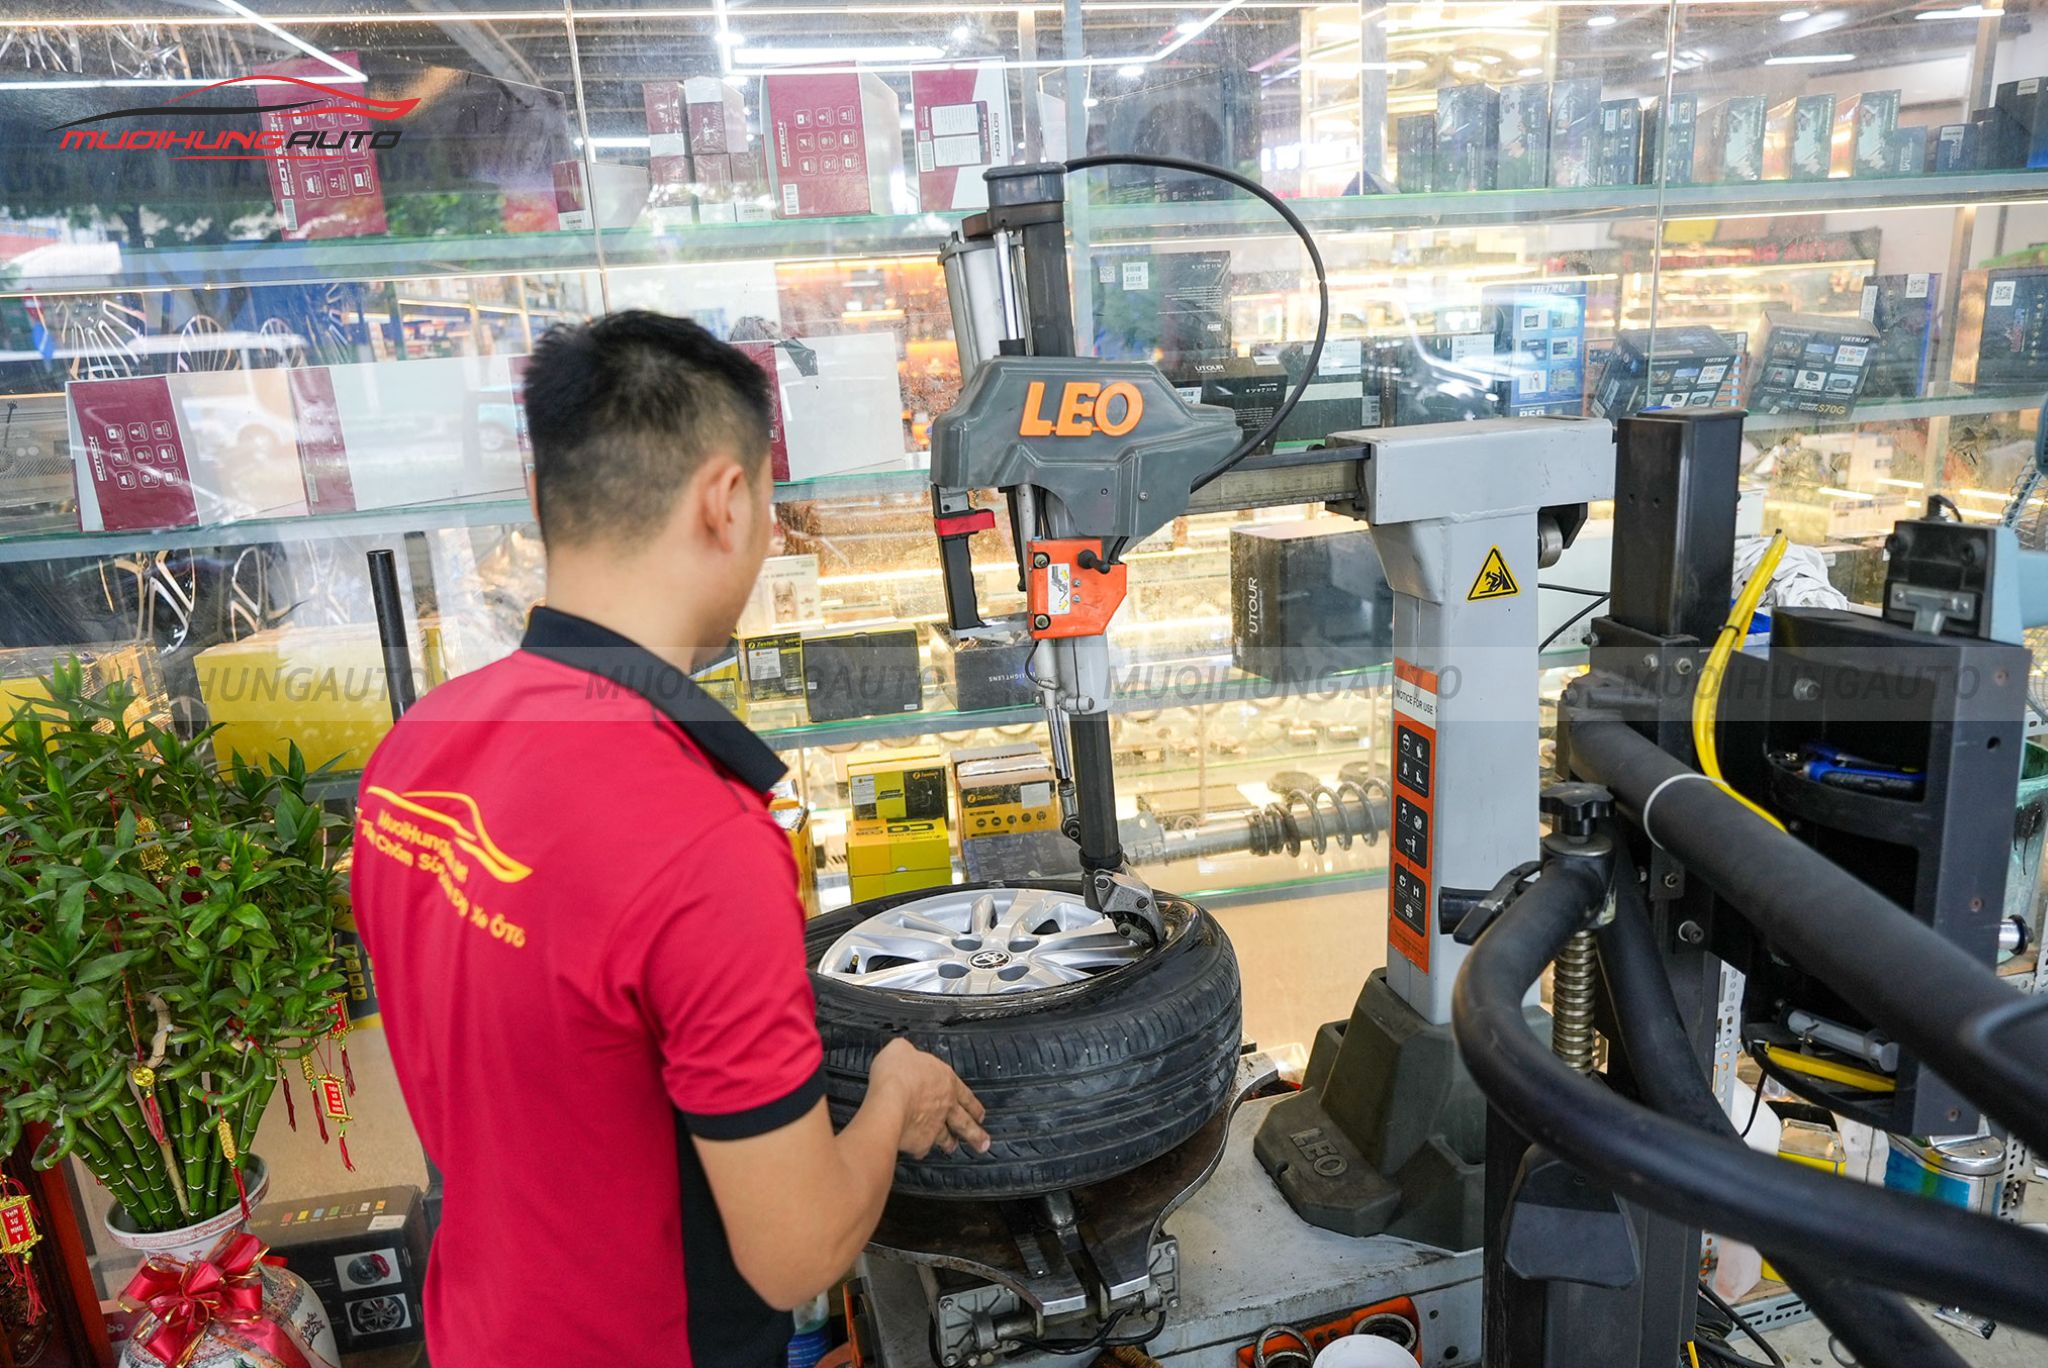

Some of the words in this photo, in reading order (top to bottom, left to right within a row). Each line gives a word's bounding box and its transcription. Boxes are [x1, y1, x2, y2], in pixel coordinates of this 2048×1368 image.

[1019, 381, 1144, 436] LEO
[1818, 404, 1847, 415] S70G
[1249, 577, 1258, 634] UTOUR
[1289, 1127, 1348, 1177] LEO
